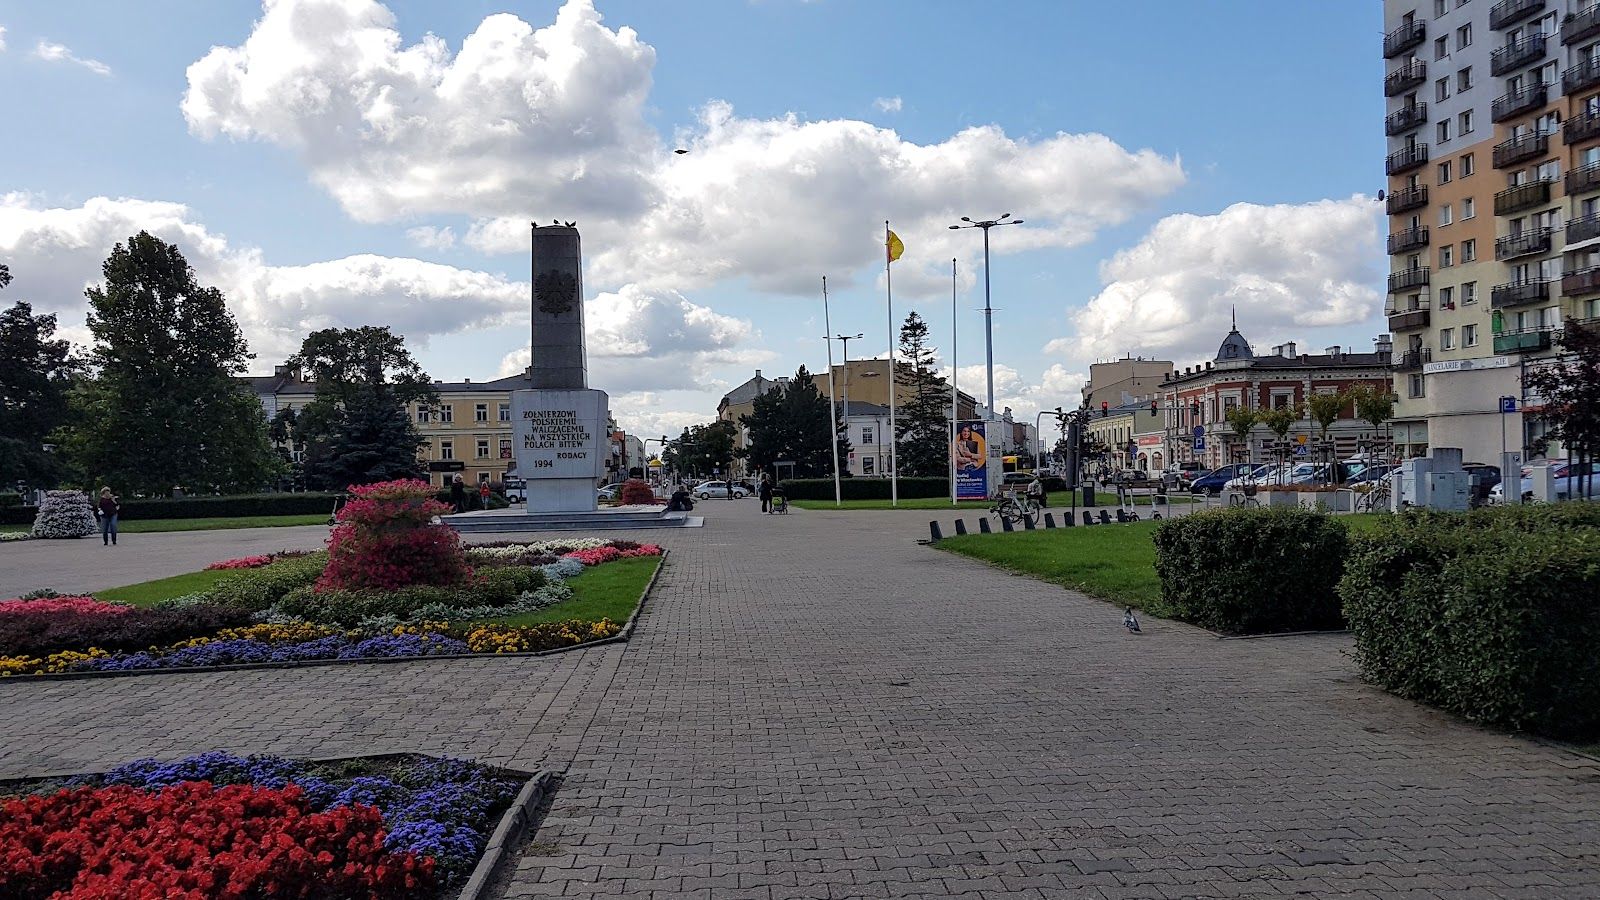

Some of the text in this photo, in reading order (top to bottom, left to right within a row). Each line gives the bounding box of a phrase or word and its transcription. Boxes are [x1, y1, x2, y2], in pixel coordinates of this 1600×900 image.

[540, 433, 590, 441] WSZYSTKICH
[1195, 438, 1203, 448] P
[534, 460, 553, 468] 1994
